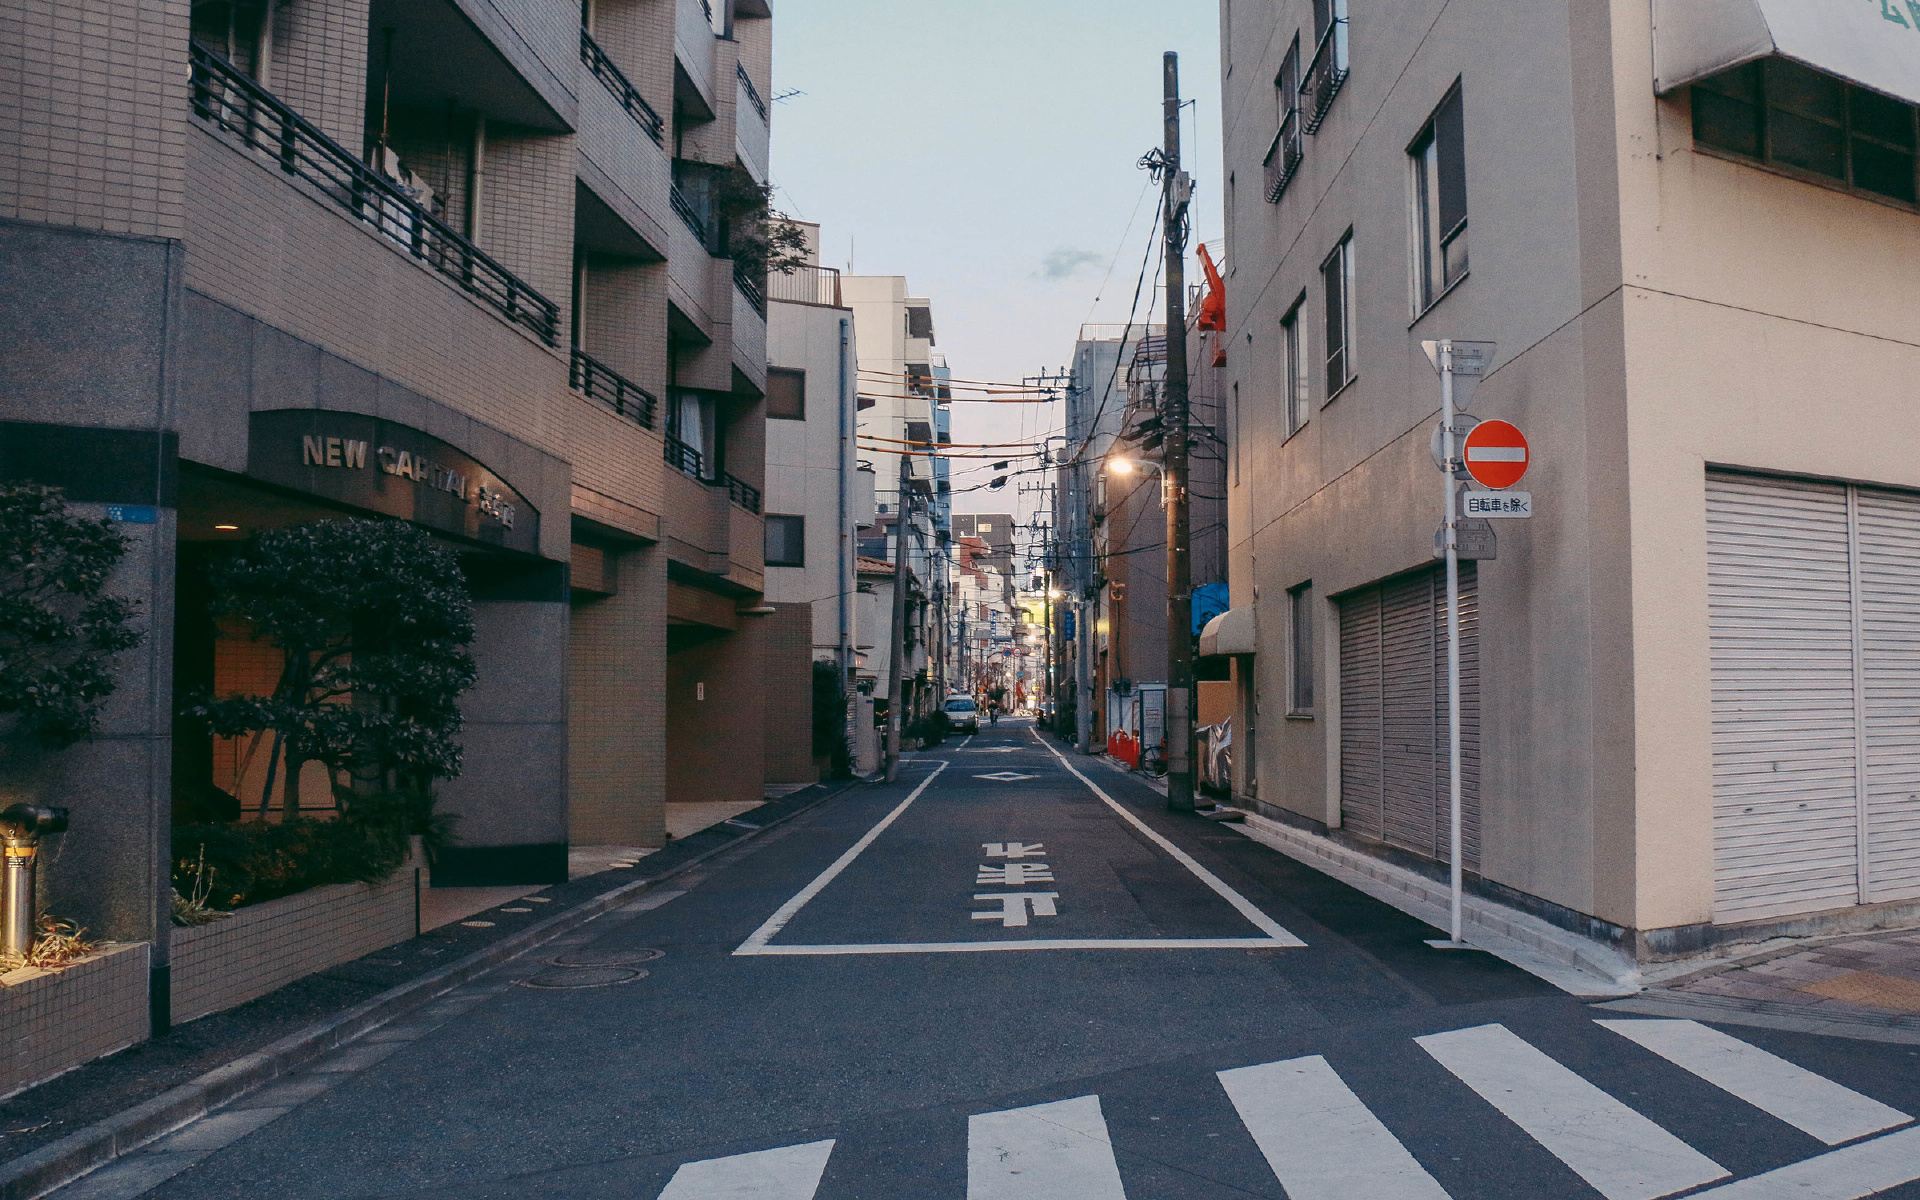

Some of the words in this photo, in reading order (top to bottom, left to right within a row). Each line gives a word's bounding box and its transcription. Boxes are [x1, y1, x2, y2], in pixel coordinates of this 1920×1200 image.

[303, 435, 368, 469] NEW
[1469, 498, 1528, 512] 自転車を除く
[971, 842, 1060, 927] 止まれ
